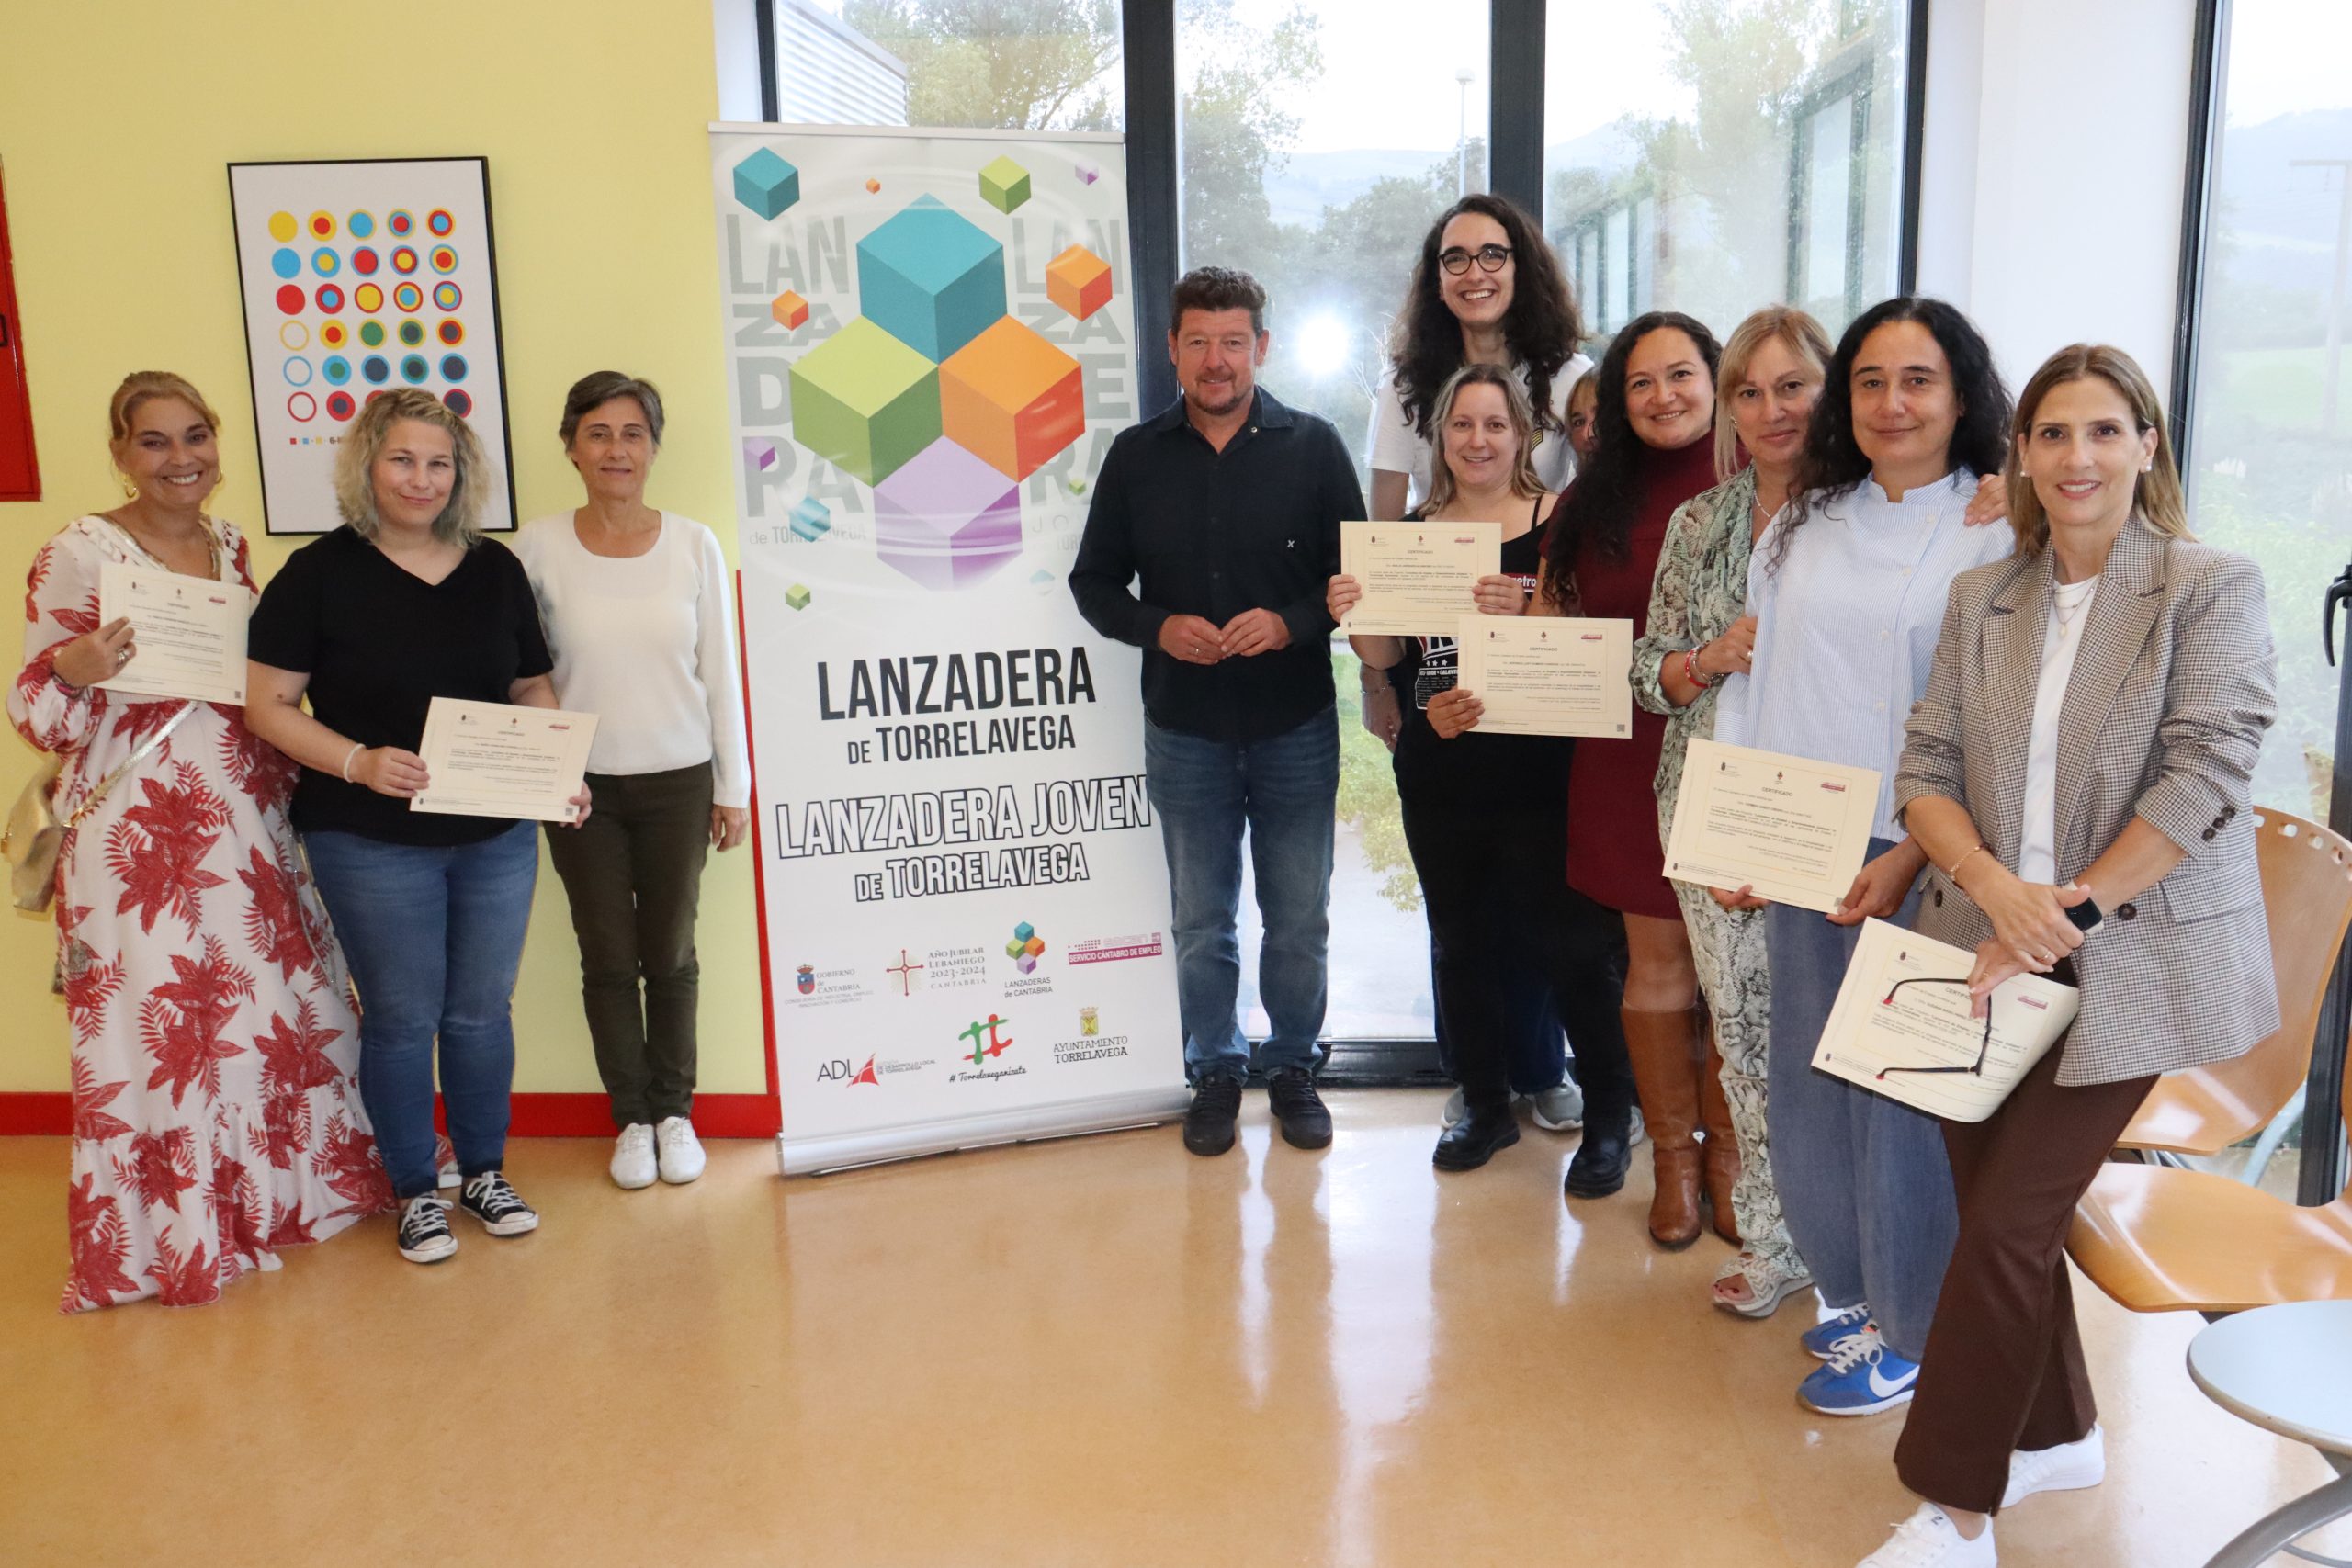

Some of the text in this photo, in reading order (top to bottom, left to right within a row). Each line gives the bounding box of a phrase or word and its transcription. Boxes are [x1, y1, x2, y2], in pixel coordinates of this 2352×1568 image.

[726, 214, 850, 294] LAN
[1514, 575, 1537, 588] etro
[817, 646, 1097, 721] LANZADERA
[847, 714, 1076, 764] DE TORRELAVEGA
[775, 774, 1151, 859] LANZADERA JOVEN
[854, 842, 1090, 902] DE TORRELAVEGA
[928, 946, 985, 960] AÑO JUBILAR
[1069, 953, 1097, 963] SERVICIO
[1138, 945, 1161, 955] EMPLEO
[929, 956, 986, 969] LEBANIEGO
[816, 969, 855, 979] GOBIERNO
[930, 967, 986, 979] 2023-2024
[817, 984, 861, 994] CANTABRIA
[930, 978, 987, 990] CANTABRIA
[1004, 976, 1051, 988] LANZADERAS
[1004, 987, 1054, 998] de CANTABRIA
[1053, 1036, 1128, 1053] AYUNTAMIENTO
[1054, 1047, 1129, 1064] TORRELAVEGA
[817, 1059, 854, 1082] ADL
